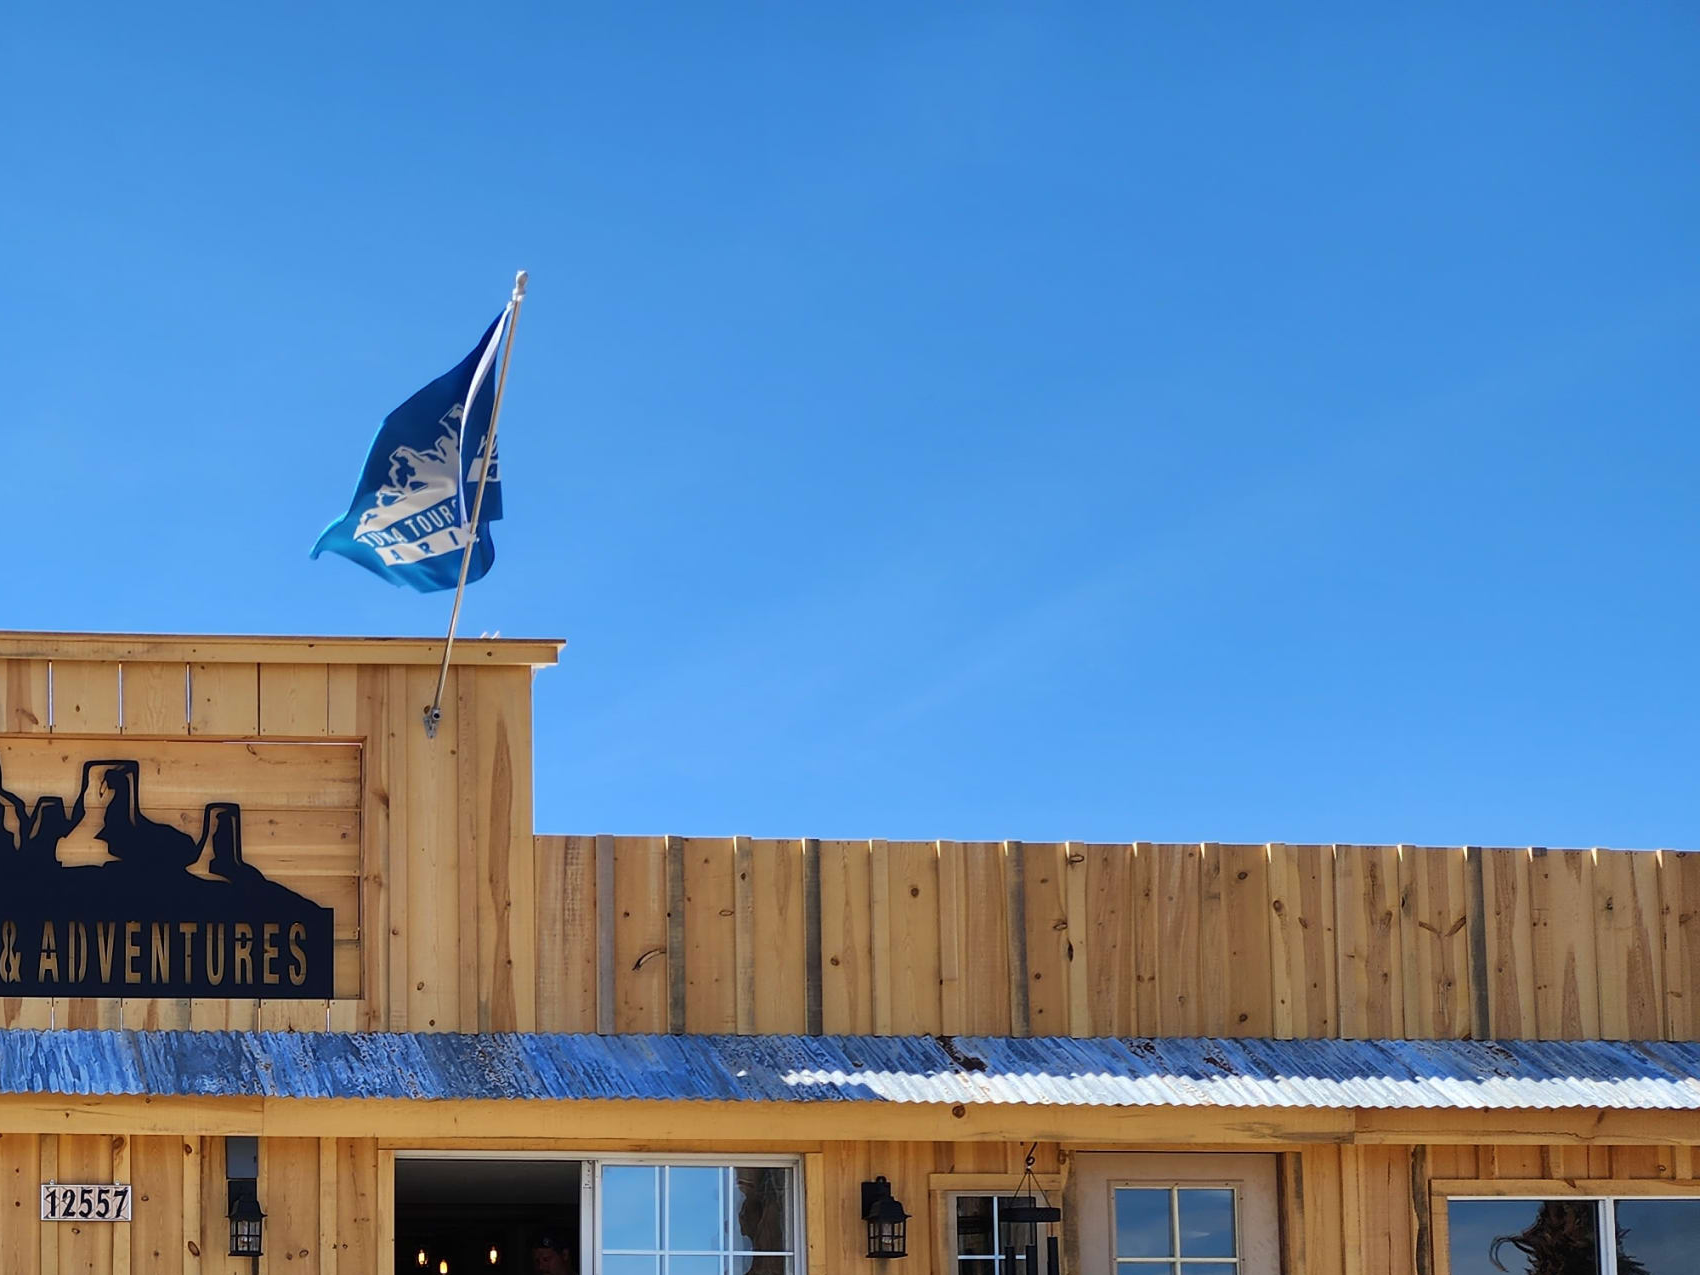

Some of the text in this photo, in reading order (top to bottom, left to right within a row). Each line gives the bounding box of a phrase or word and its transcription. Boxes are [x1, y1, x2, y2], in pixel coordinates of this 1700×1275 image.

[0, 919, 22, 984] &
[37, 919, 308, 987] ADVENTURES
[46, 1189, 128, 1217] 12557
